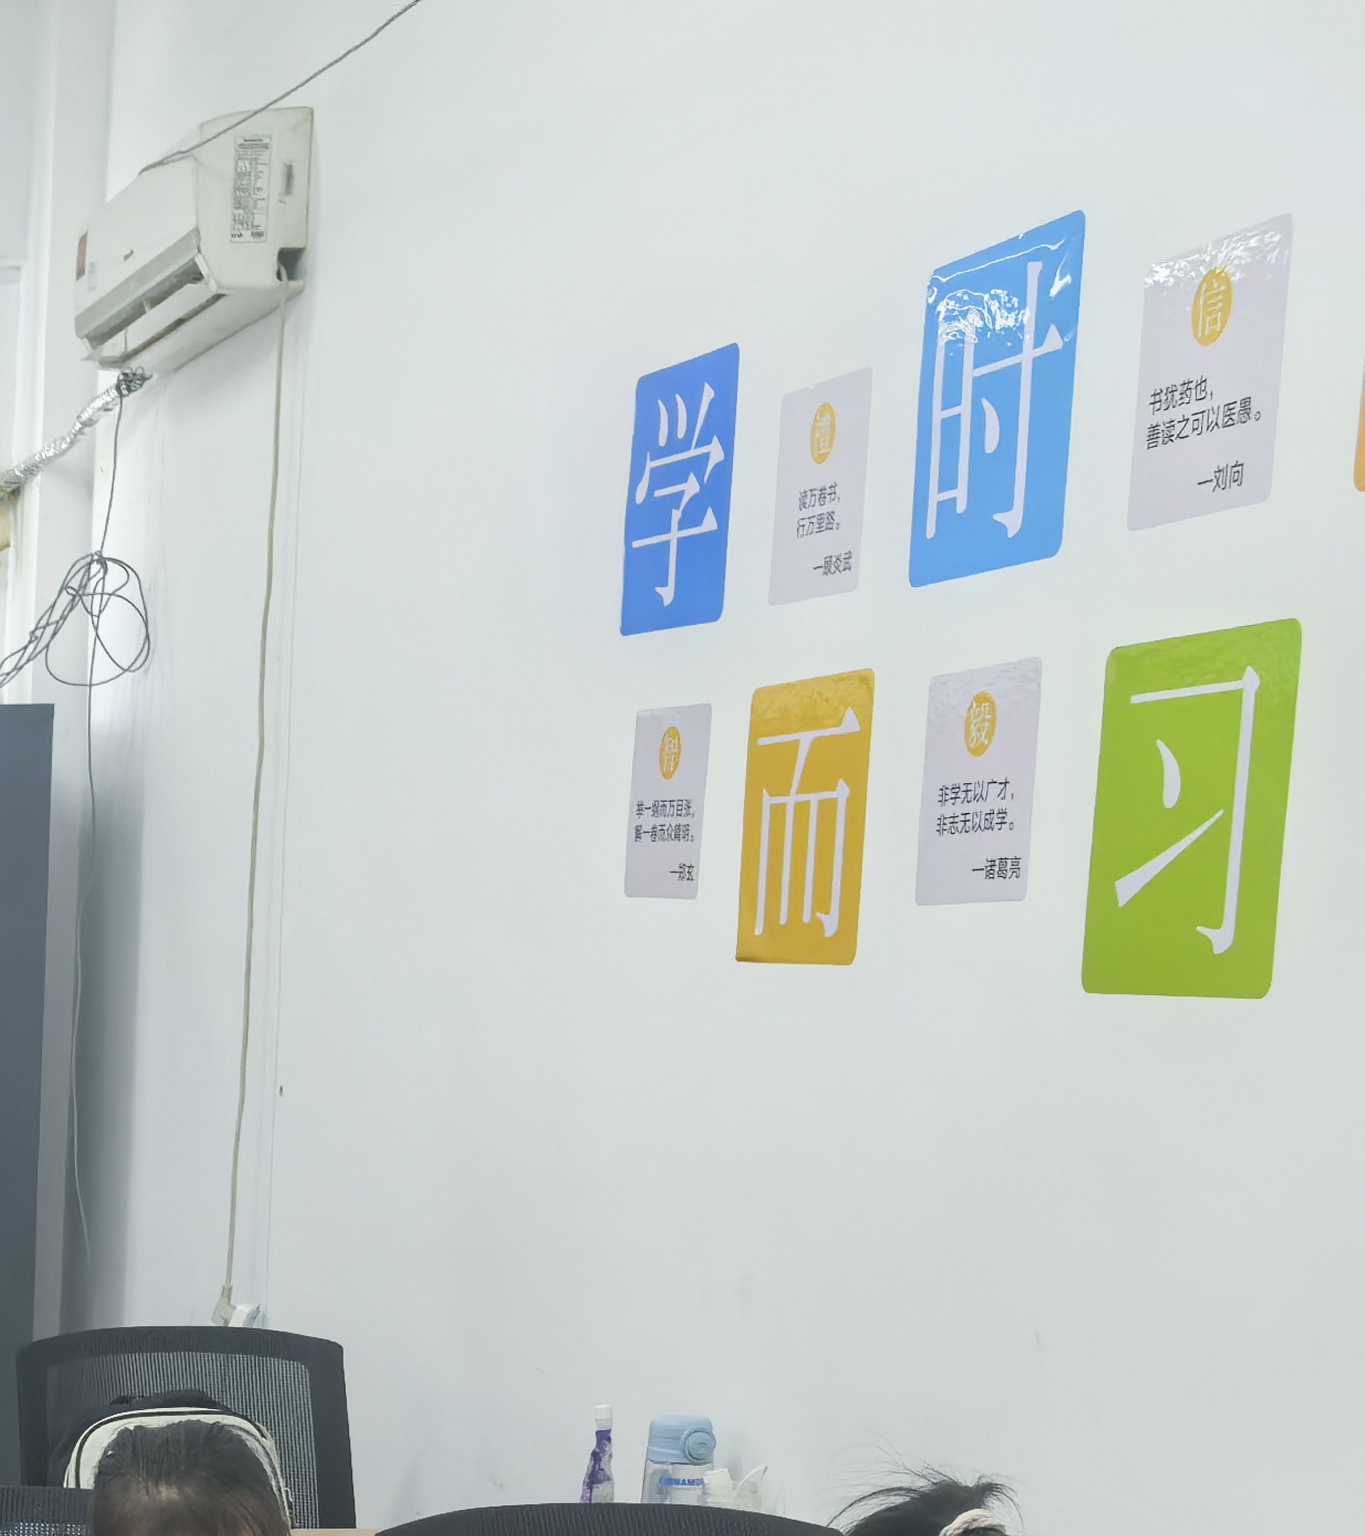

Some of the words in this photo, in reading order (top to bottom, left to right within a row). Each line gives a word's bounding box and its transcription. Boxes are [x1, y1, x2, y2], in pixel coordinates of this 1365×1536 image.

[632, 382, 725, 608] 学
[925, 262, 1064, 538] 时
[754, 706, 860, 938] 而
[1115, 665, 1261, 955] 习
